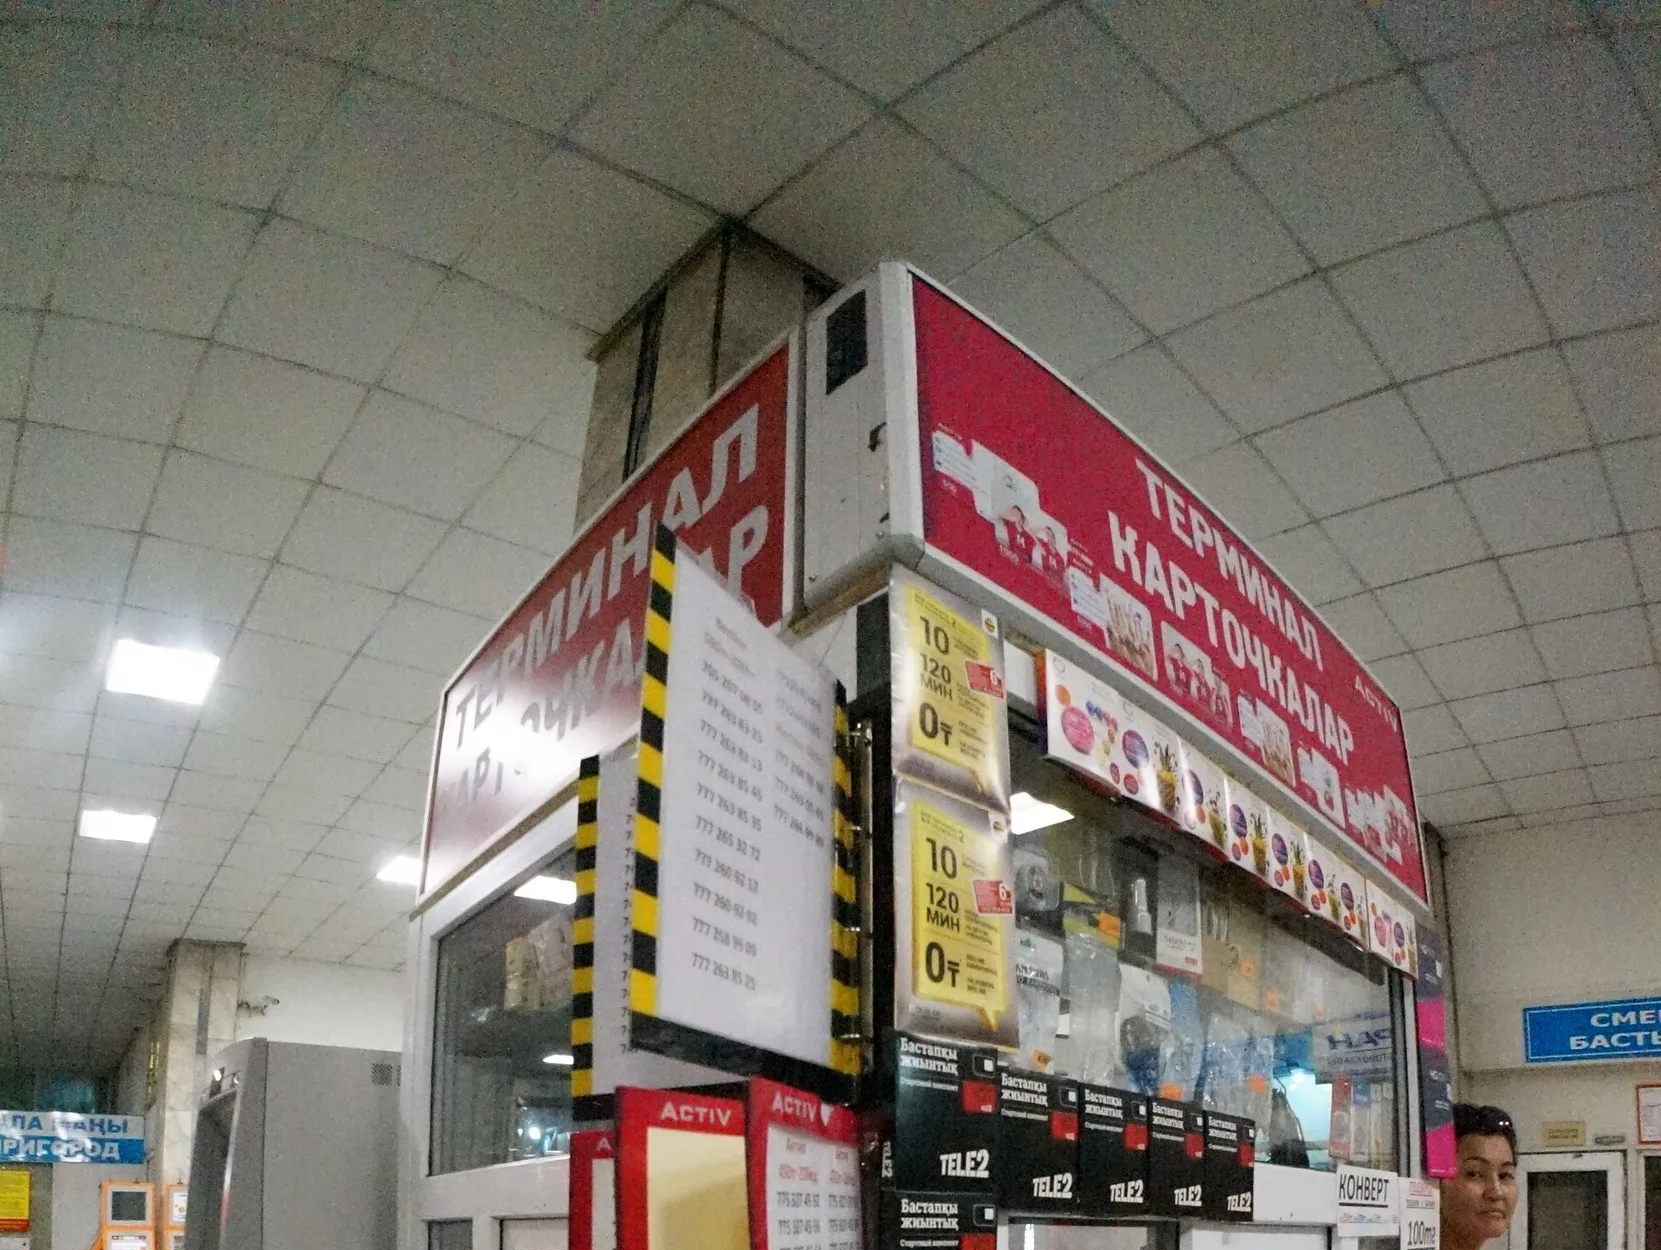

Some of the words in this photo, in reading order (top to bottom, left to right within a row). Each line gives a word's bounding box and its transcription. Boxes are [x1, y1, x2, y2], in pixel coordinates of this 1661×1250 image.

[455, 403, 759, 750] ТЕРМИНАЛ
[1136, 458, 1324, 672] ТЕРМИНАЛ
[919, 615, 950, 656] 10
[1108, 511, 1355, 767] КАРТОЧКАЛАР
[919, 653, 952, 684] 120
[920, 672, 953, 701] МИН
[926, 838, 958, 880] 10
[926, 882, 959, 914] 120
[926, 906, 960, 934] МИН
[1590, 1009, 1661, 1028] СМЕ
[659, 1101, 732, 1127] ACTIV
[771, 1091, 818, 1123] ACTIV
[0, 1138, 121, 1161] РИГОРОД
[939, 1149, 990, 1179] TELE2
[1032, 1172, 1073, 1199] TELE2
[1110, 1179, 1144, 1204] TELE2
[1174, 1184, 1202, 1207] TELE2
[1338, 1173, 1390, 1202] КОНВЕРТ
[1227, 1192, 1251, 1212] TELE2
